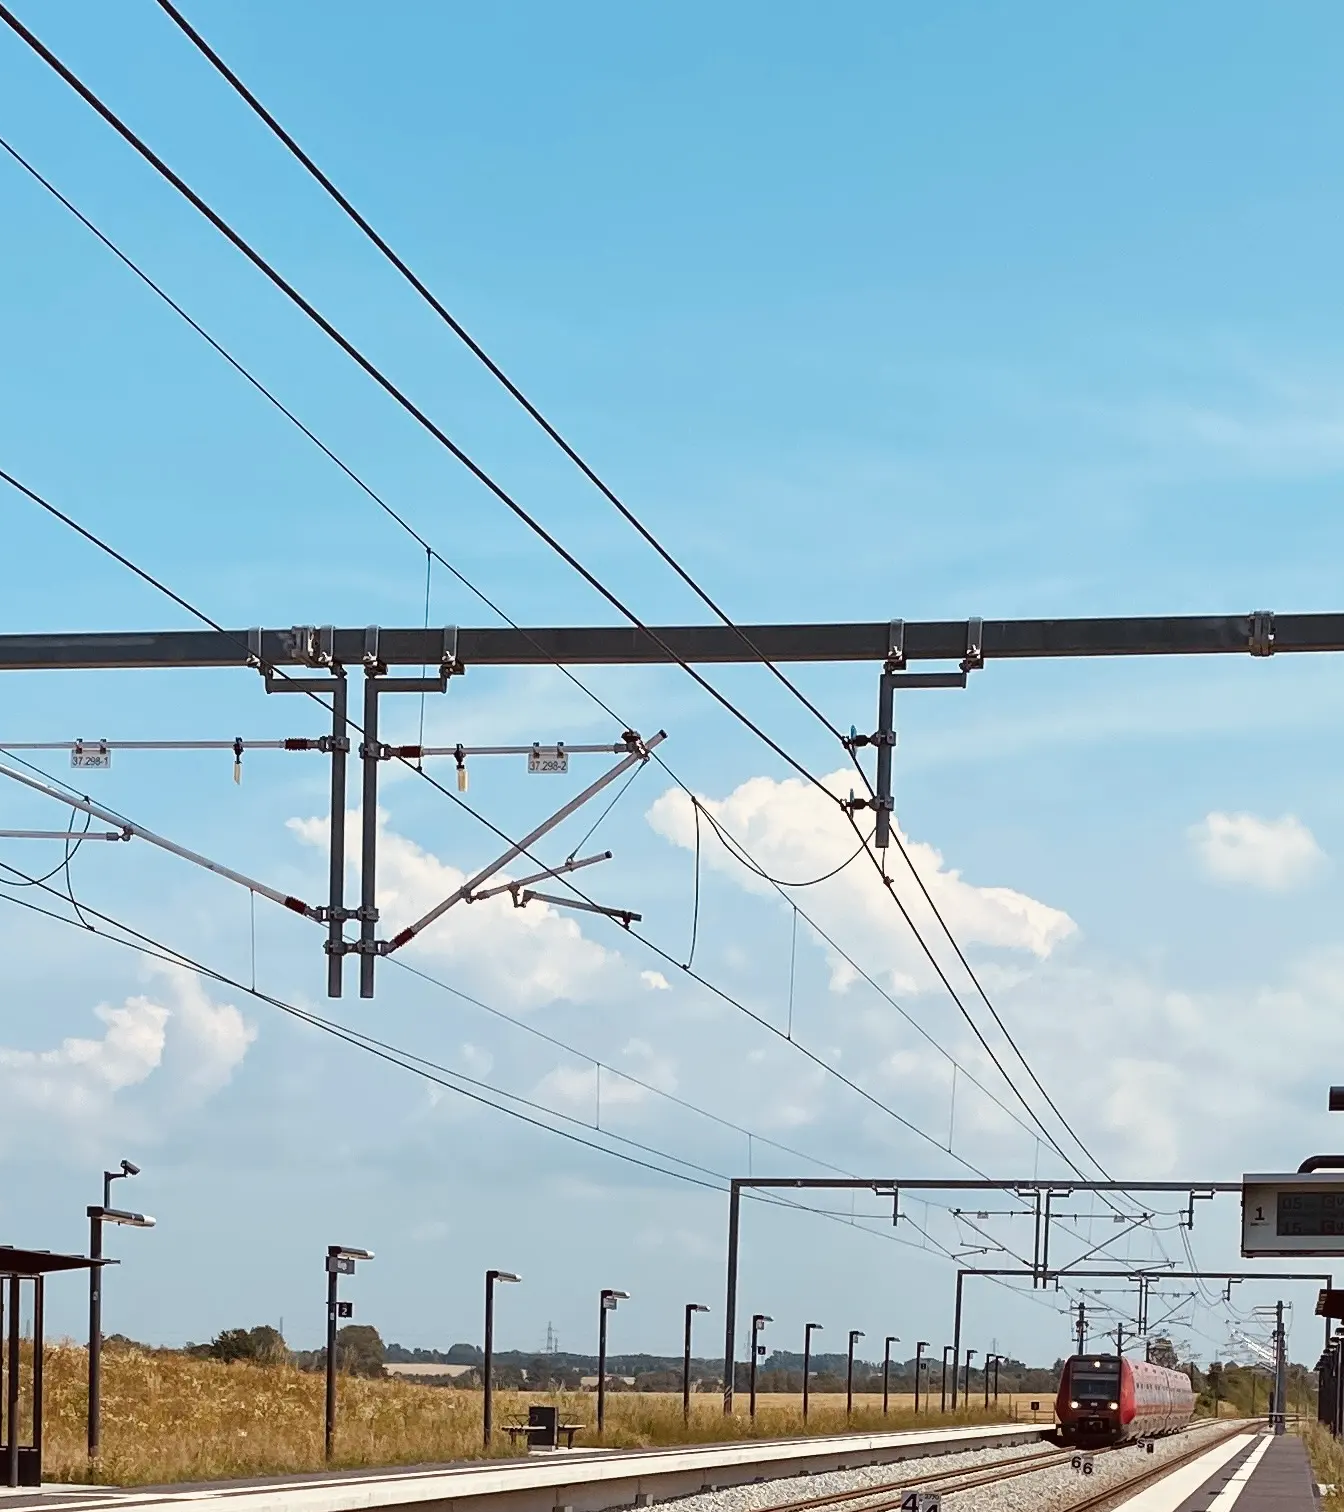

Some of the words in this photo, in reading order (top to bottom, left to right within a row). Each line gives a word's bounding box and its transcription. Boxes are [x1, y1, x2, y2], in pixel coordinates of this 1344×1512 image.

[1254, 1206, 1265, 1220] 1
[1071, 1456, 1082, 1469] 6
[1083, 1462, 1093, 1475] 6
